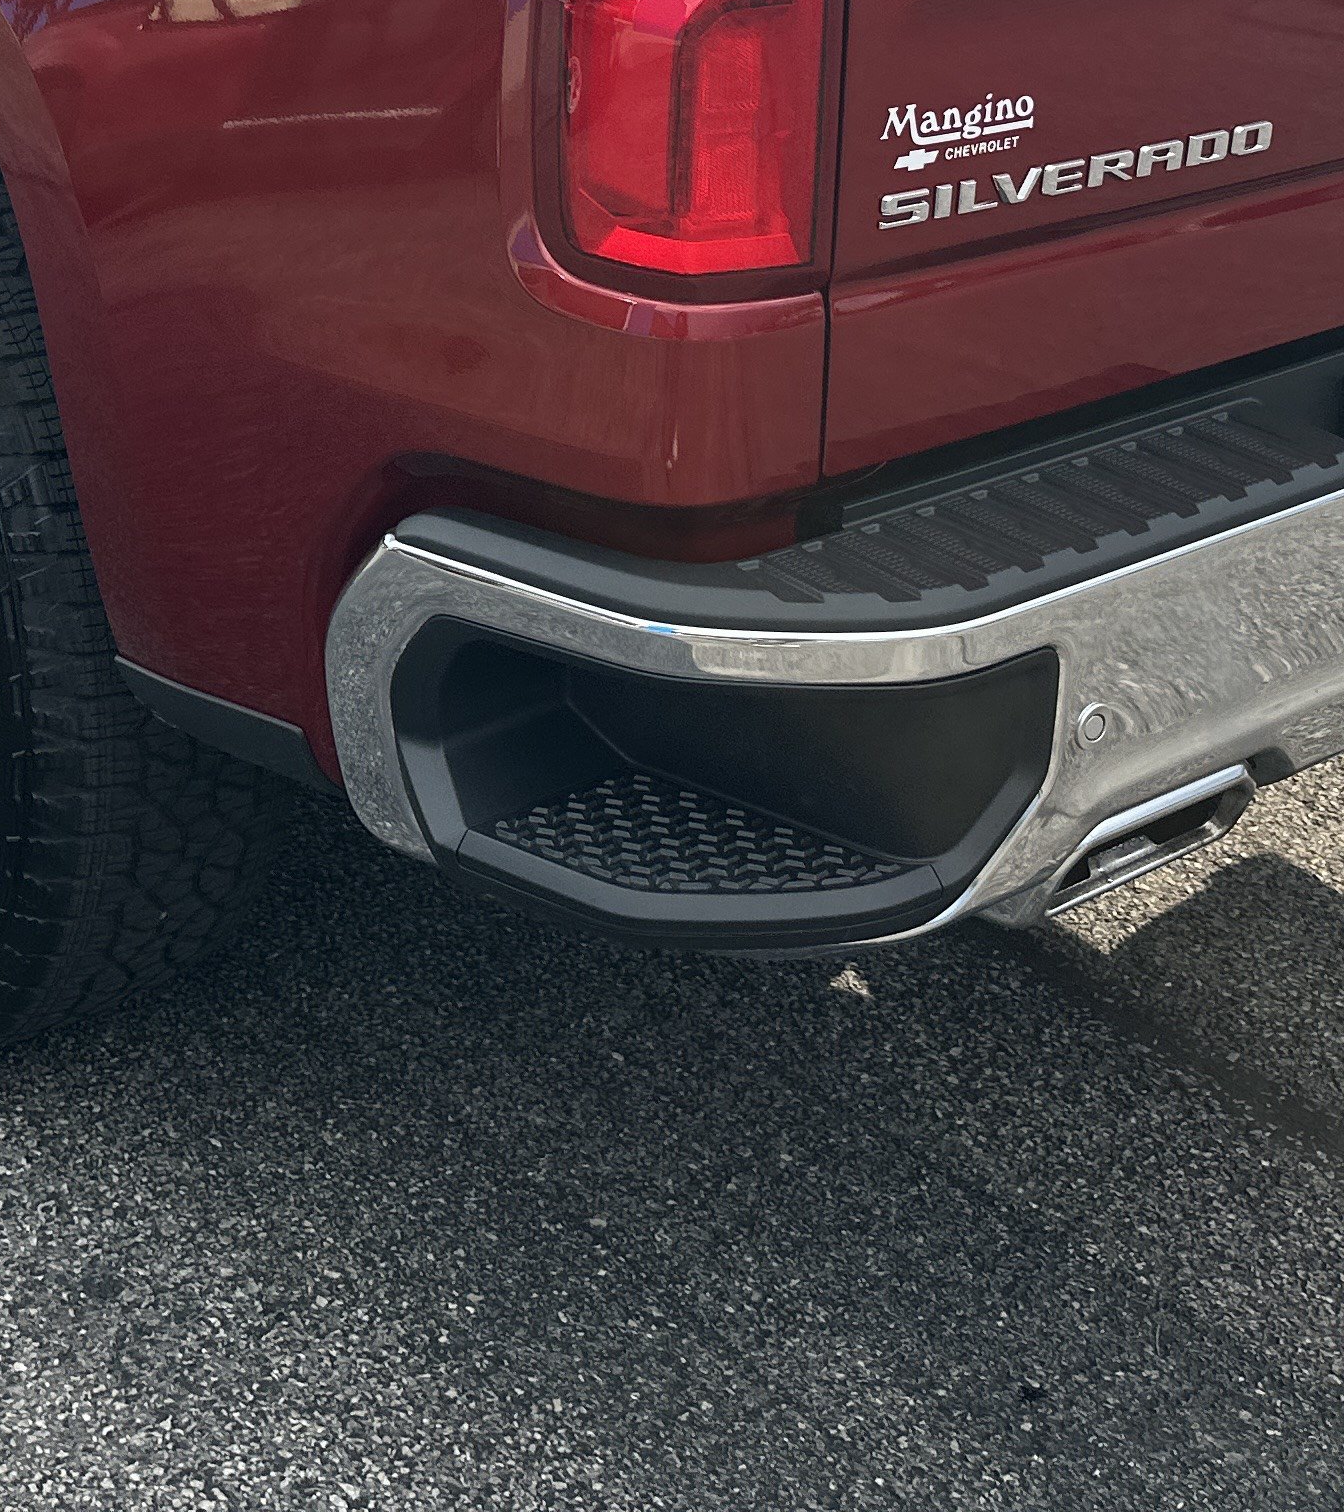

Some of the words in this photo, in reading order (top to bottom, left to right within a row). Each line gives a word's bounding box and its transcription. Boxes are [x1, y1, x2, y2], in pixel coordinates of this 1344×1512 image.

[880, 92, 1035, 145] Mangino
[944, 135, 1020, 161] CHEVROLET
[877, 120, 1273, 230] SILVERADO
